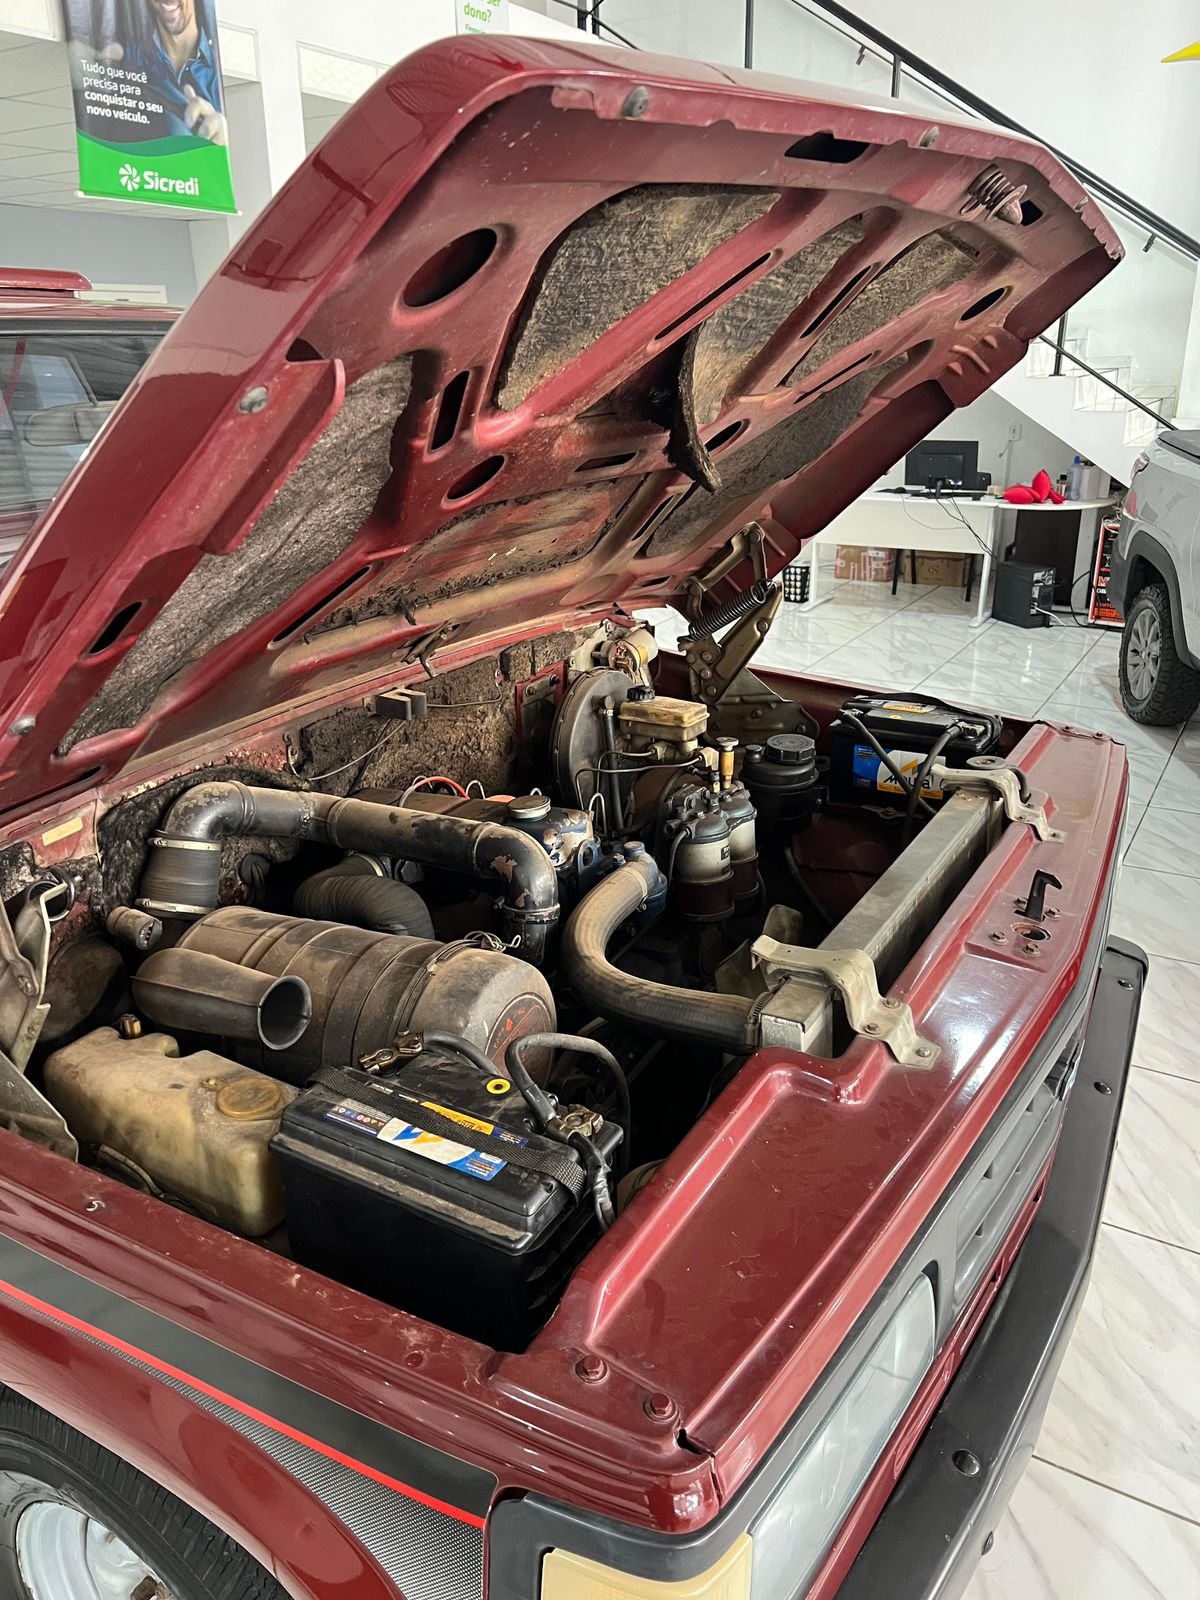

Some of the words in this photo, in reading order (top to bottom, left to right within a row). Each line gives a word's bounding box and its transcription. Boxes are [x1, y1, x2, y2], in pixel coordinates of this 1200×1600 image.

[463, 2, 492, 23] dono?
[80, 59, 105, 75] Tudo
[107, 67, 124, 80] que
[126, 70, 148, 84] você
[83, 76, 119, 92] precisa
[119, 82, 141, 95] para
[84, 90, 137, 109] conquistar
[138, 101, 145, 110] o
[146, 102, 163, 113] seu
[86, 104, 112, 118] novo
[112, 108, 150, 124] veículo.
[143, 171, 199, 196] Sicredi
